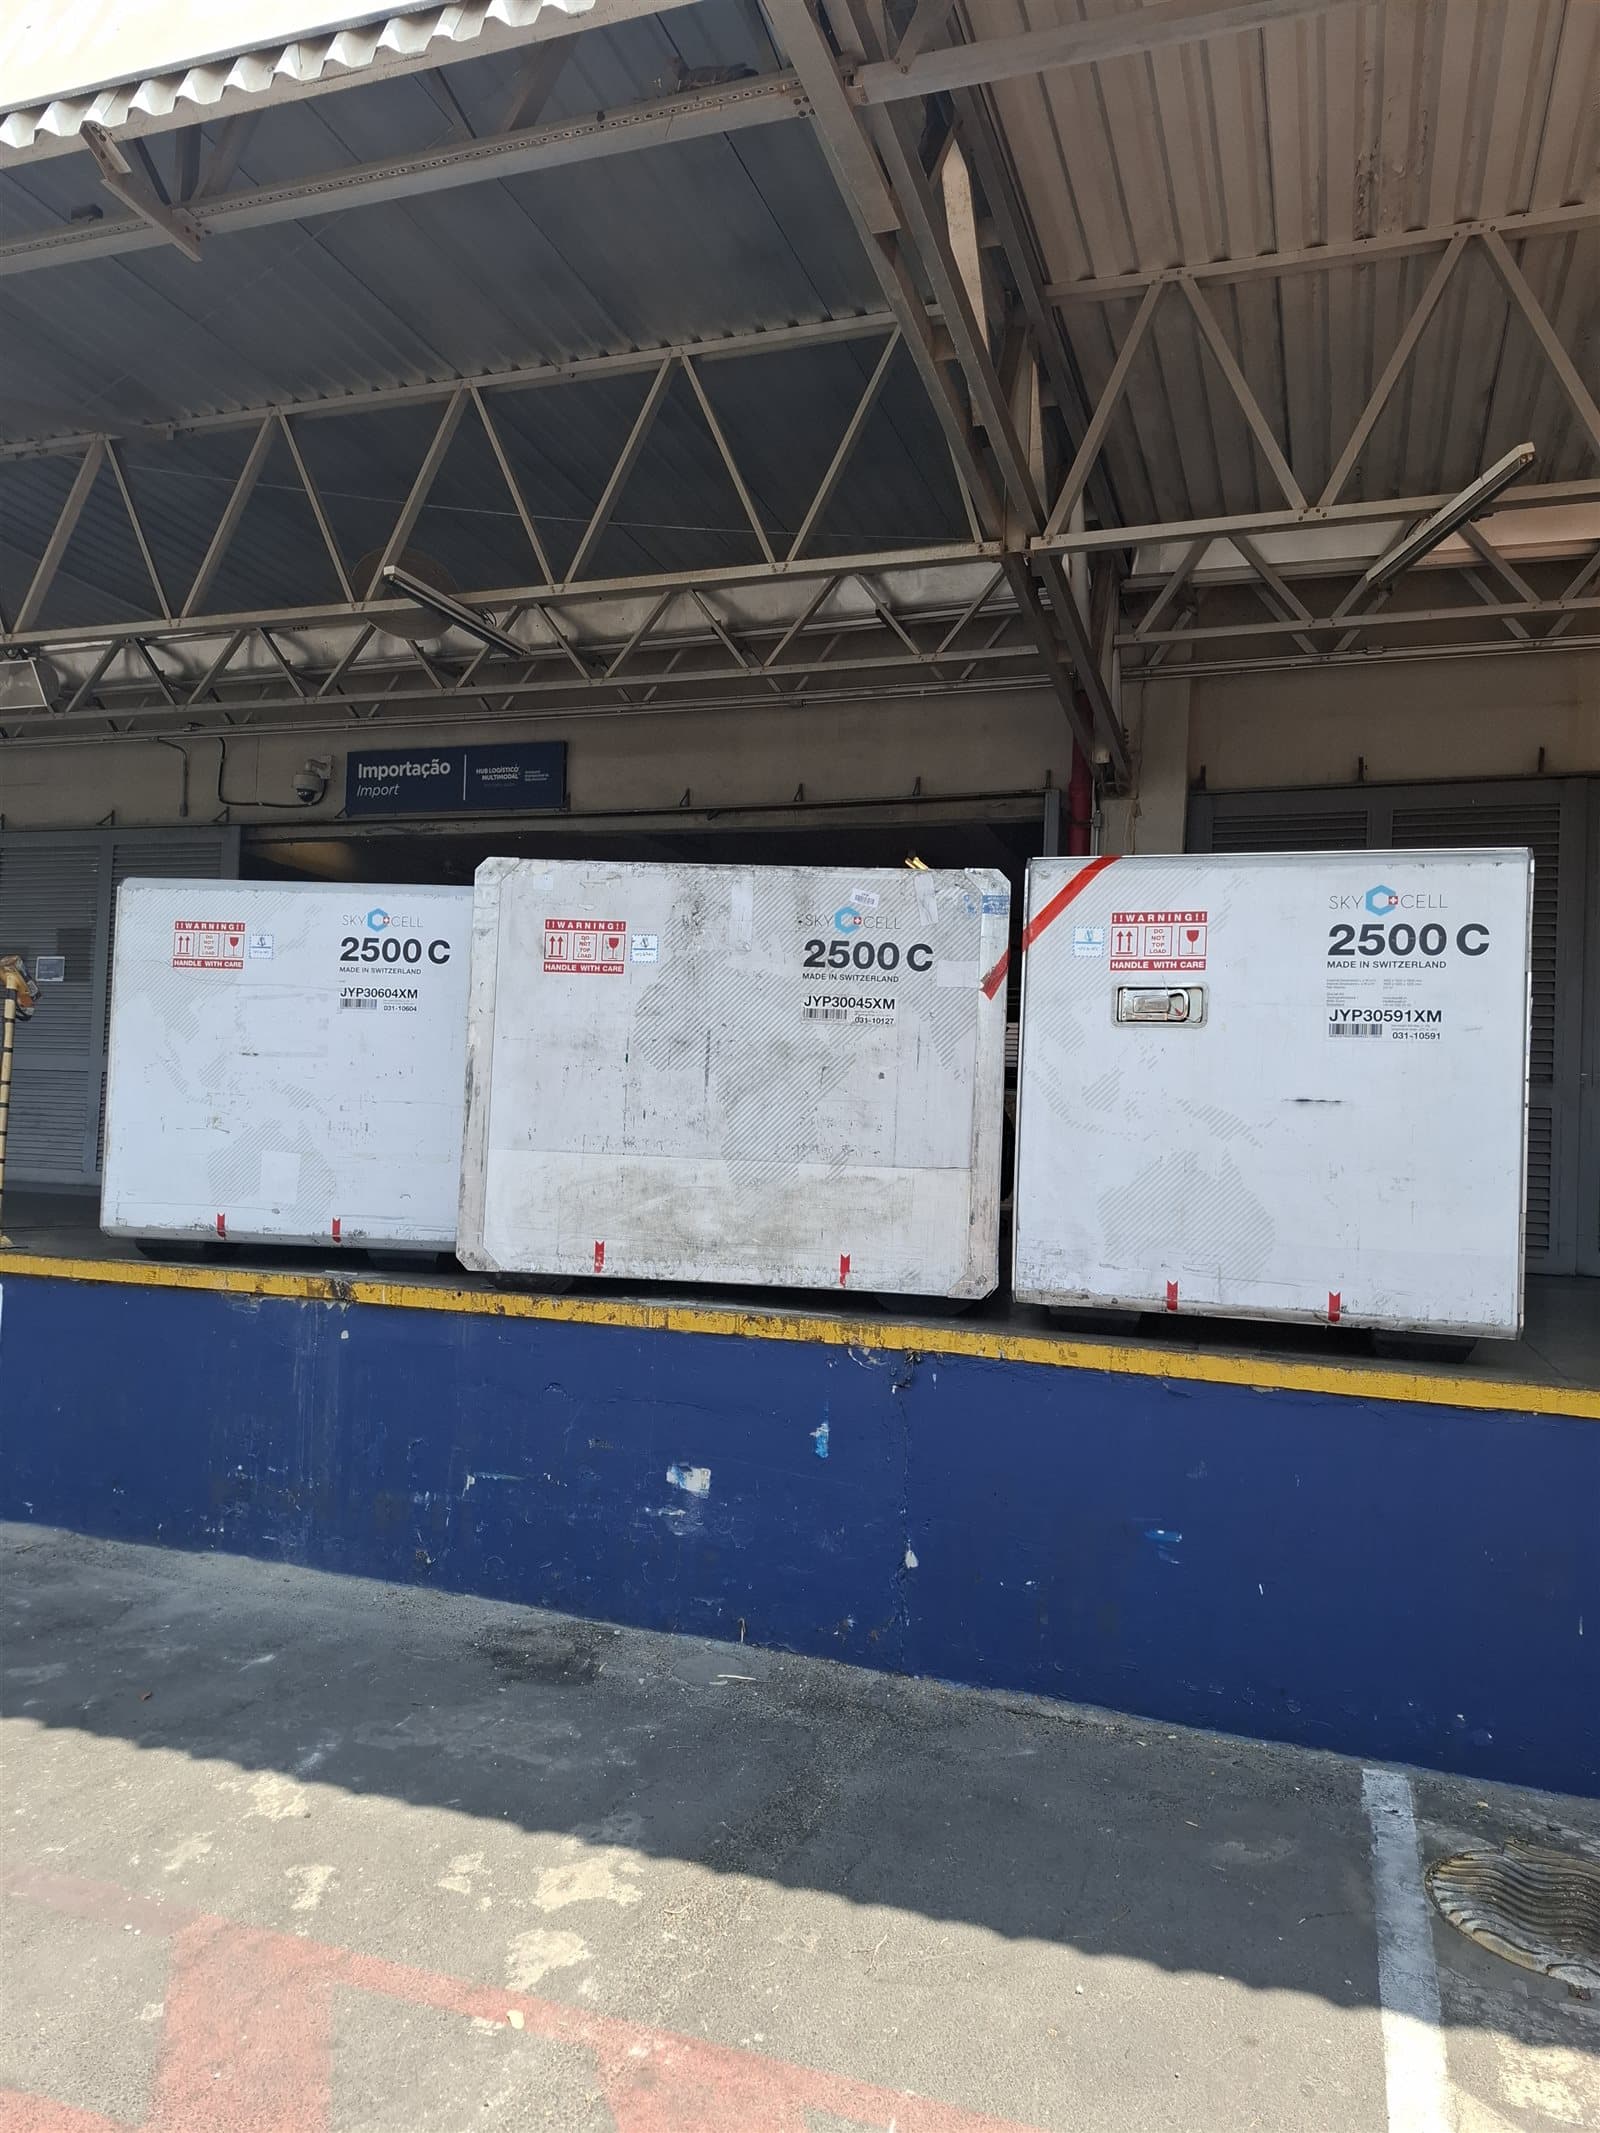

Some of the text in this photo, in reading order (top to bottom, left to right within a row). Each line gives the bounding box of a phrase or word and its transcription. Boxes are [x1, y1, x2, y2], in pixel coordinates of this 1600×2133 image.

[357, 759, 451, 781] Importação
[356, 784, 400, 798] Import
[1327, 923, 1490, 956] 2500 C
[339, 937, 451, 964] 2500 C
[803, 939, 934, 972] 2500 C
[174, 959, 202, 967] HANDLE
[545, 963, 623, 973] HANDLE WITH CARE
[1111, 961, 1205, 969] HANDLE WITH CARE
[1326, 960, 1447, 969] MADE IN SWITZERLAND
[370, 967, 422, 975] SWITZERLAND
[839, 974, 900, 983] SWITZERLAND
[340, 987, 418, 999] JYP30604XM
[803, 995, 895, 1010] JYP30045XM
[854, 1016, 895, 1025] 031-10127
[1329, 1009, 1442, 1023] JYP30591XM
[1392, 1031, 1441, 1040] 031-10591
